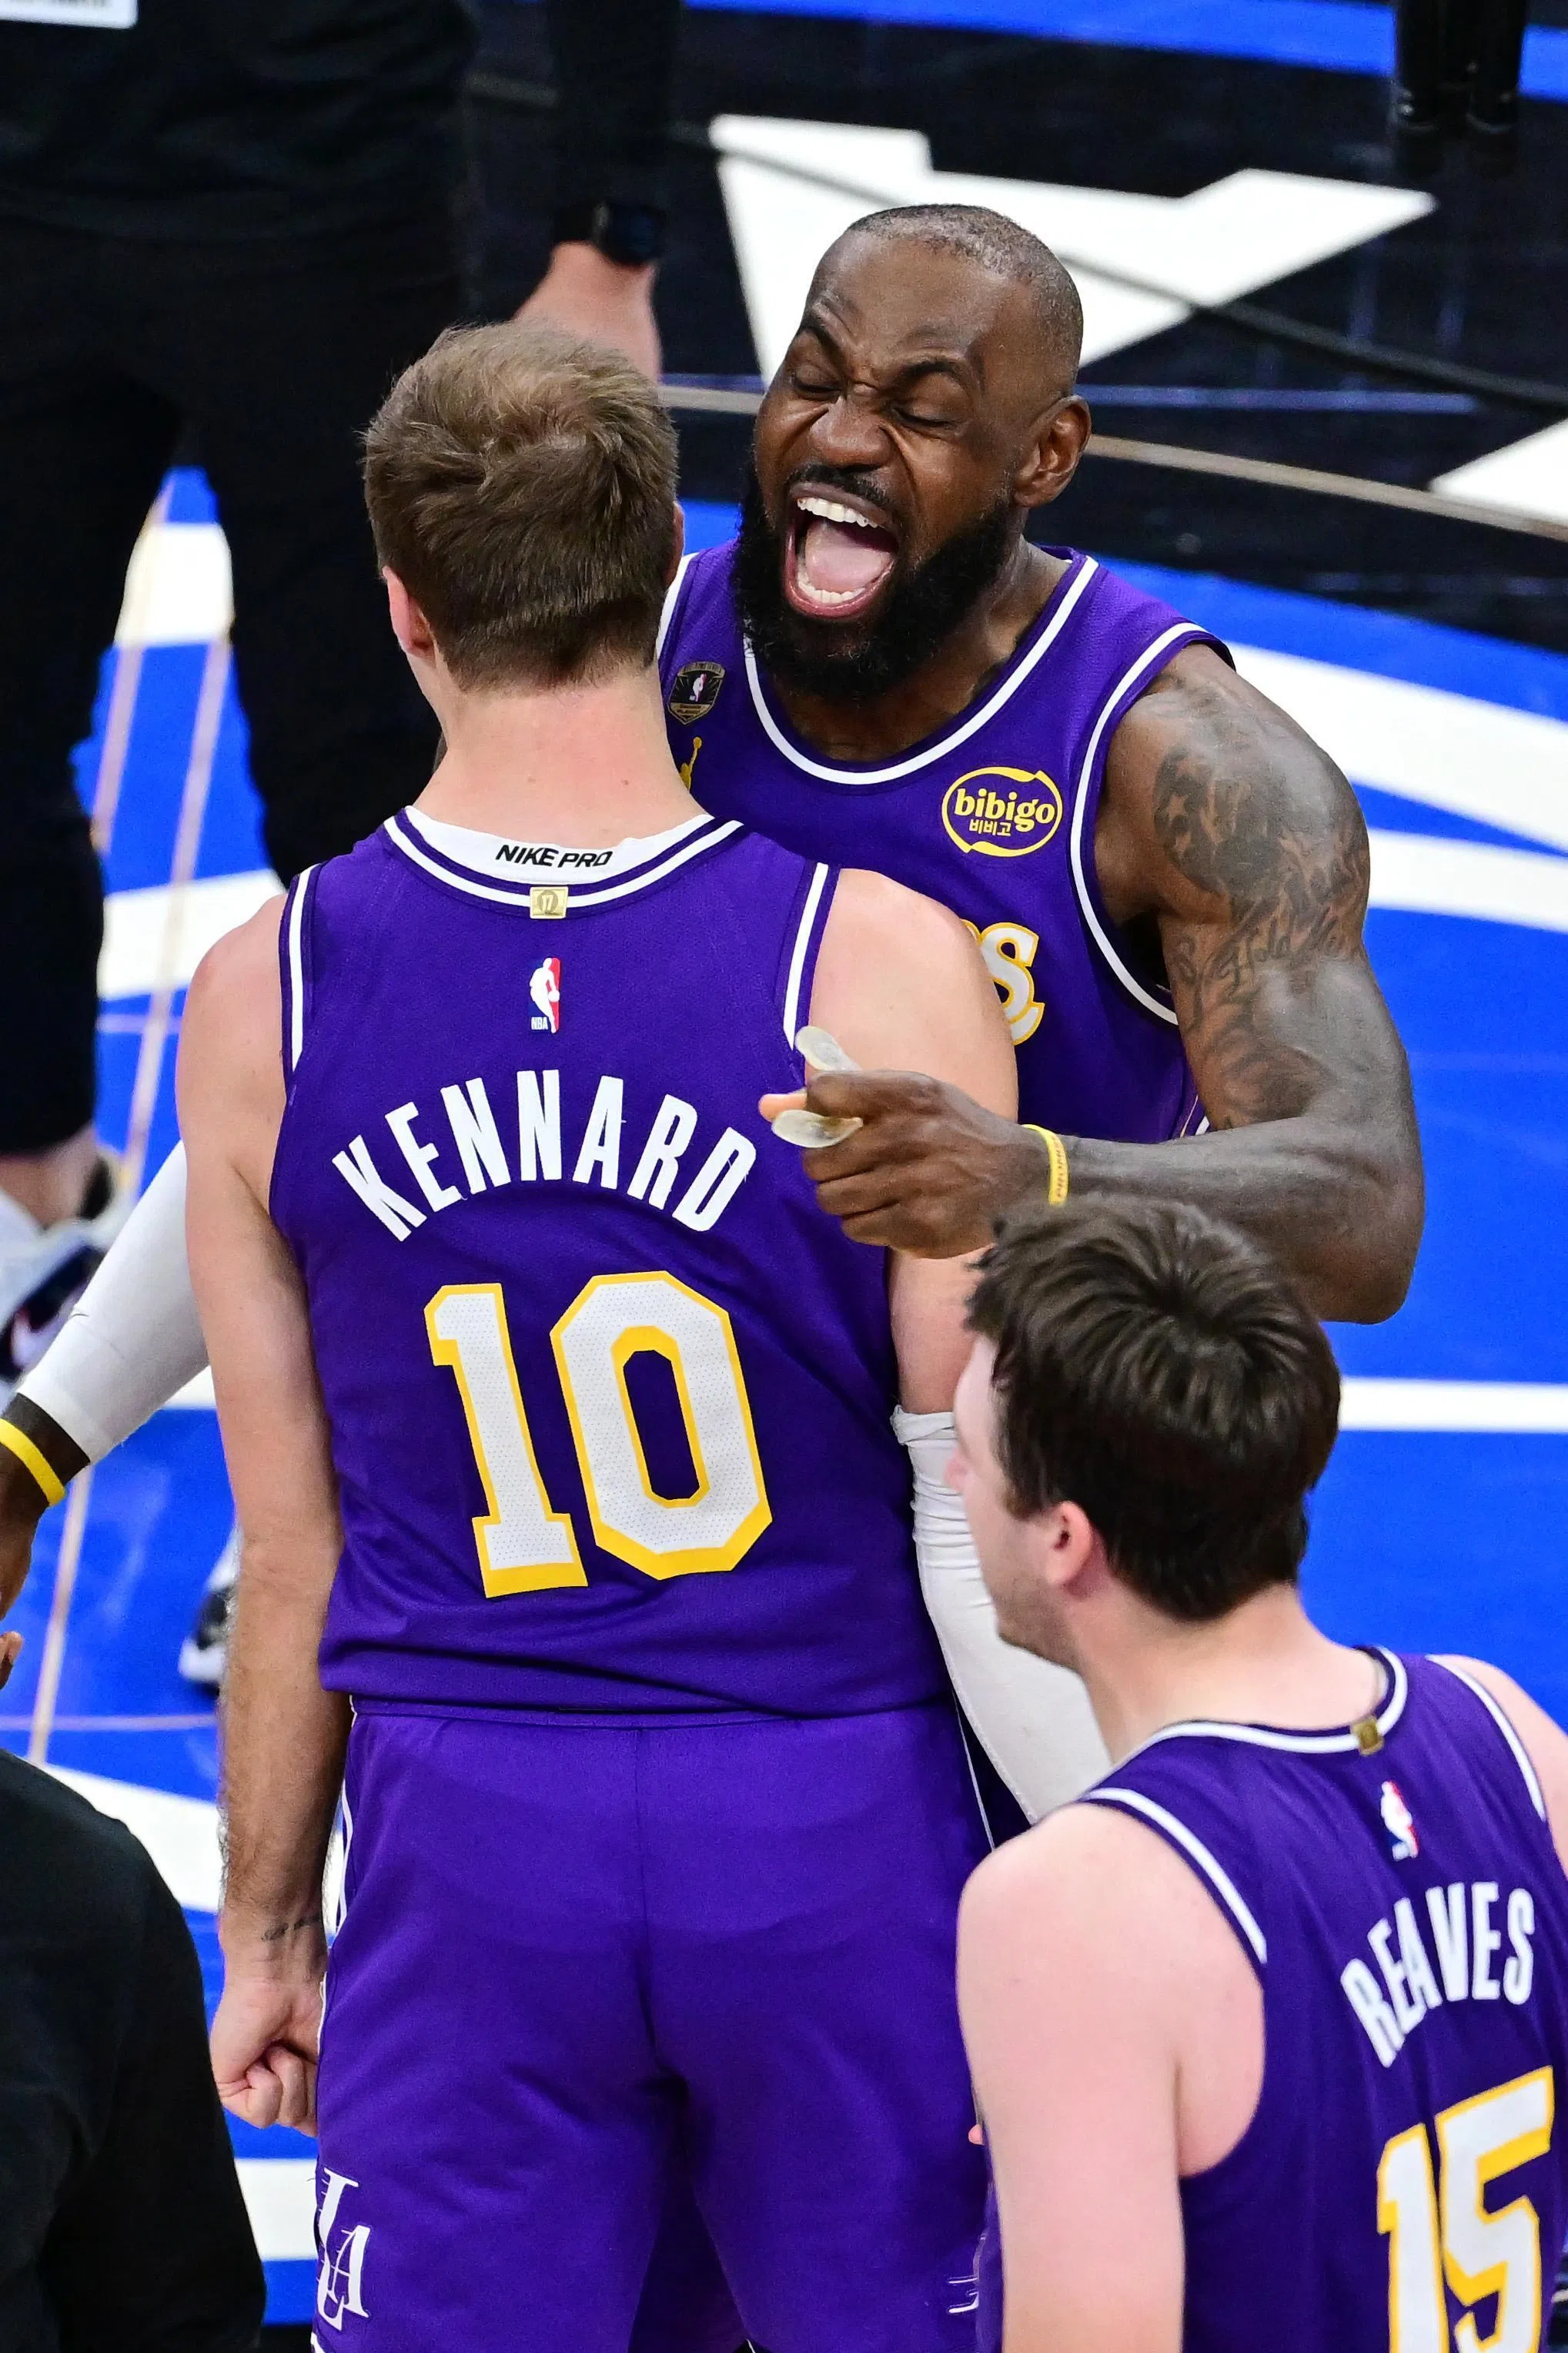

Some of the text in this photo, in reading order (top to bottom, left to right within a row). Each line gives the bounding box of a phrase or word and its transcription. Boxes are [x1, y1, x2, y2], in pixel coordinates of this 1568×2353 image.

[495, 844, 613, 869] NIKE PRO
[954, 788, 1055, 832] bibigo
[969, 818, 1011, 837] 비비고
[530, 1016, 549, 1030] NBA
[332, 1069, 757, 1242] KENNARD
[423, 1270, 774, 1599] 10
[1340, 1881, 1536, 2069] REAVES
[1376, 2065, 1555, 2353] 15
